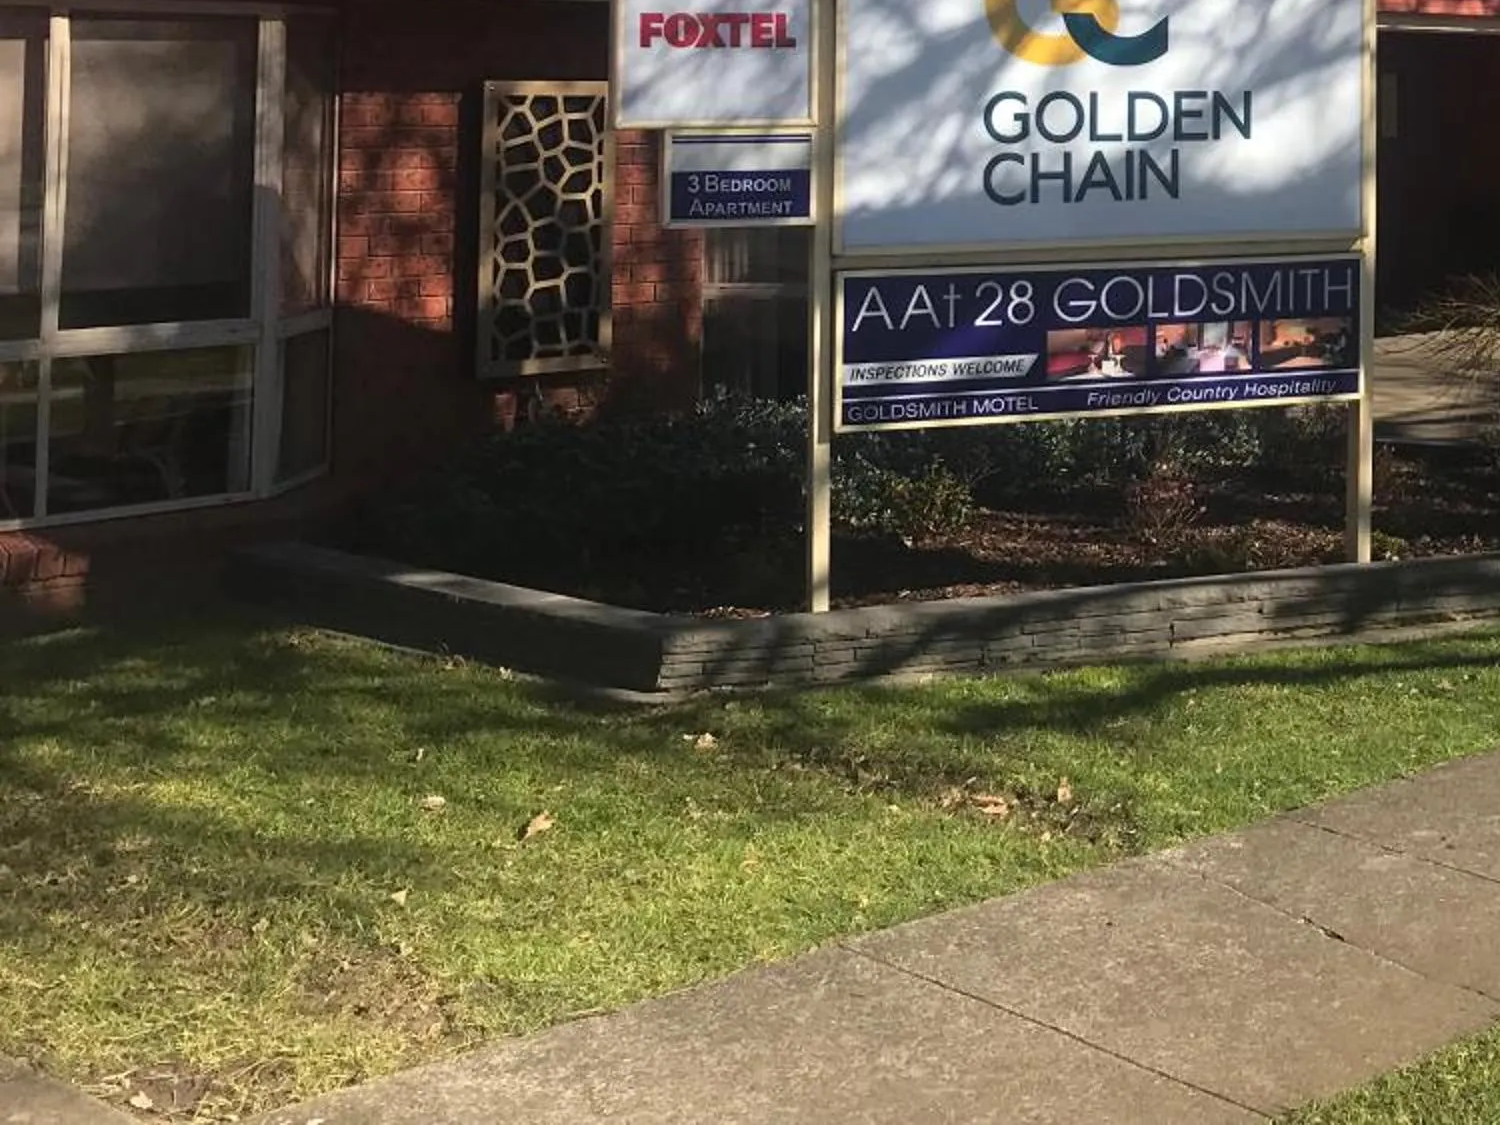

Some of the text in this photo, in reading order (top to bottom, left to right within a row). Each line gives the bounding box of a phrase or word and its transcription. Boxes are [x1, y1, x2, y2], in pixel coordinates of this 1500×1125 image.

[640, 12, 796, 48] FOXTEL
[983, 90, 1252, 144] GOLDEN
[687, 174, 700, 194] 3
[983, 148, 1180, 205] CHAIN
[974, 279, 1035, 327] 28
[1053, 267, 1352, 323] GOLDSMITH
[850, 356, 1026, 382] INSPECTIONS WELCOME
[848, 396, 1039, 422] GOLDSMITH MOTEL
[1087, 377, 1337, 408] Friendly Country Hospitality
